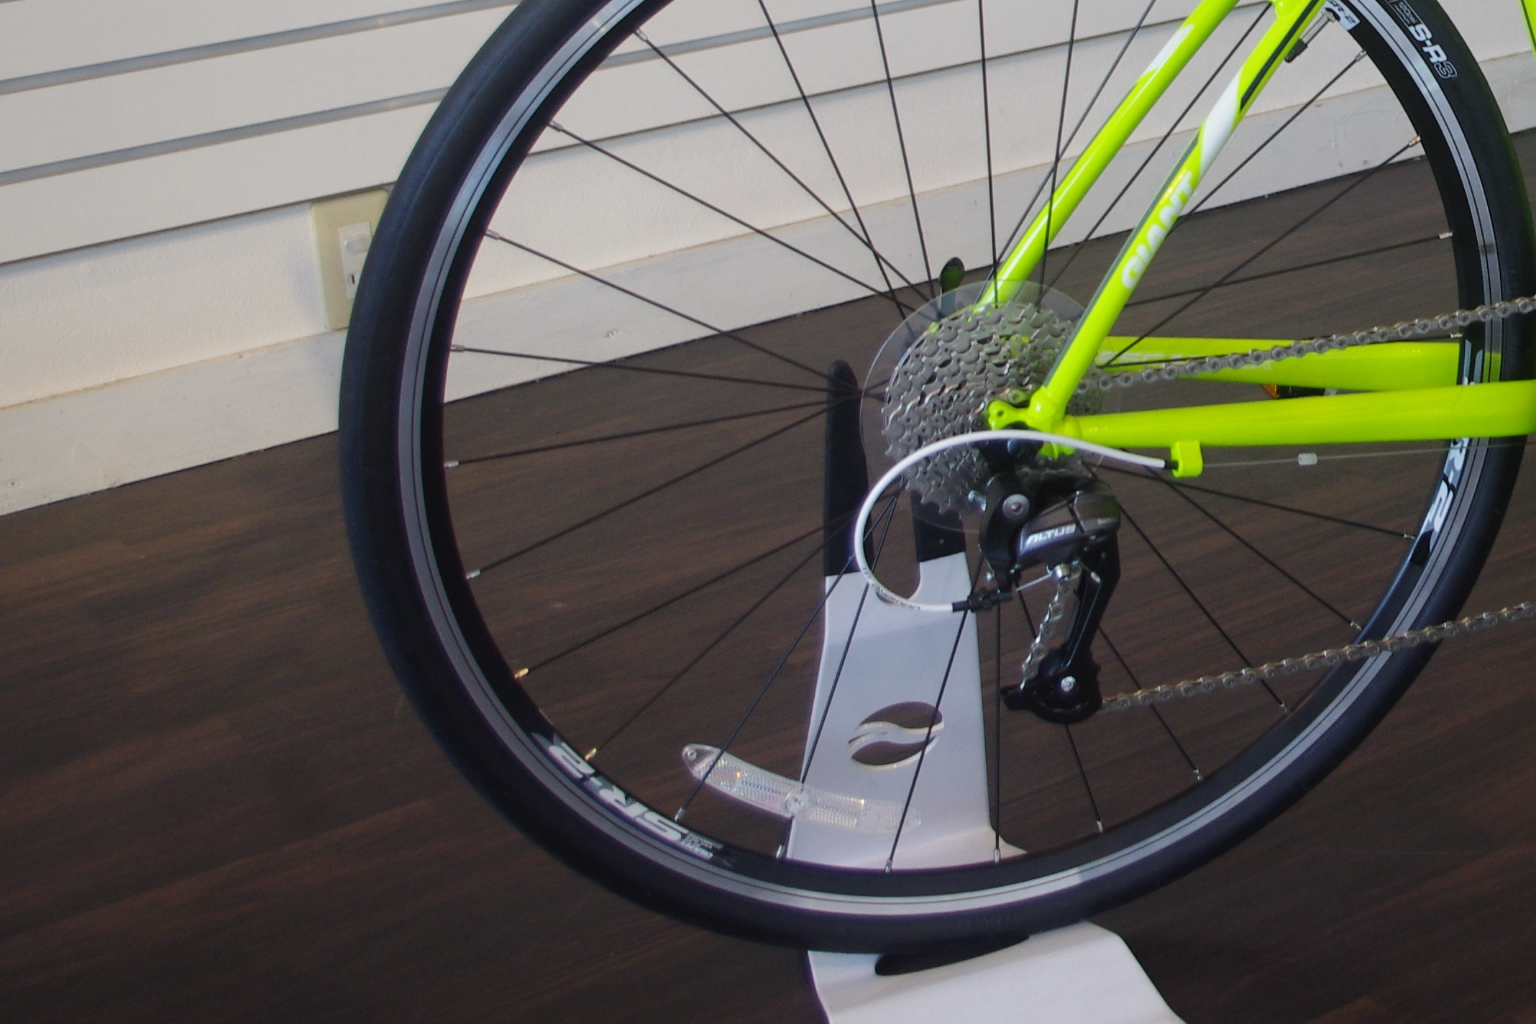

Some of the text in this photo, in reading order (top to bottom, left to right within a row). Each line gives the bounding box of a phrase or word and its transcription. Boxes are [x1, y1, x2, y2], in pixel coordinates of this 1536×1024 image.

[1408, 22, 1458, 79] S-R3
[1122, 170, 1193, 289] GIANT
[1428, 437, 1470, 533] R-2
[1025, 523, 1077, 546] ALTUS
[549, 741, 690, 842] SR-2
